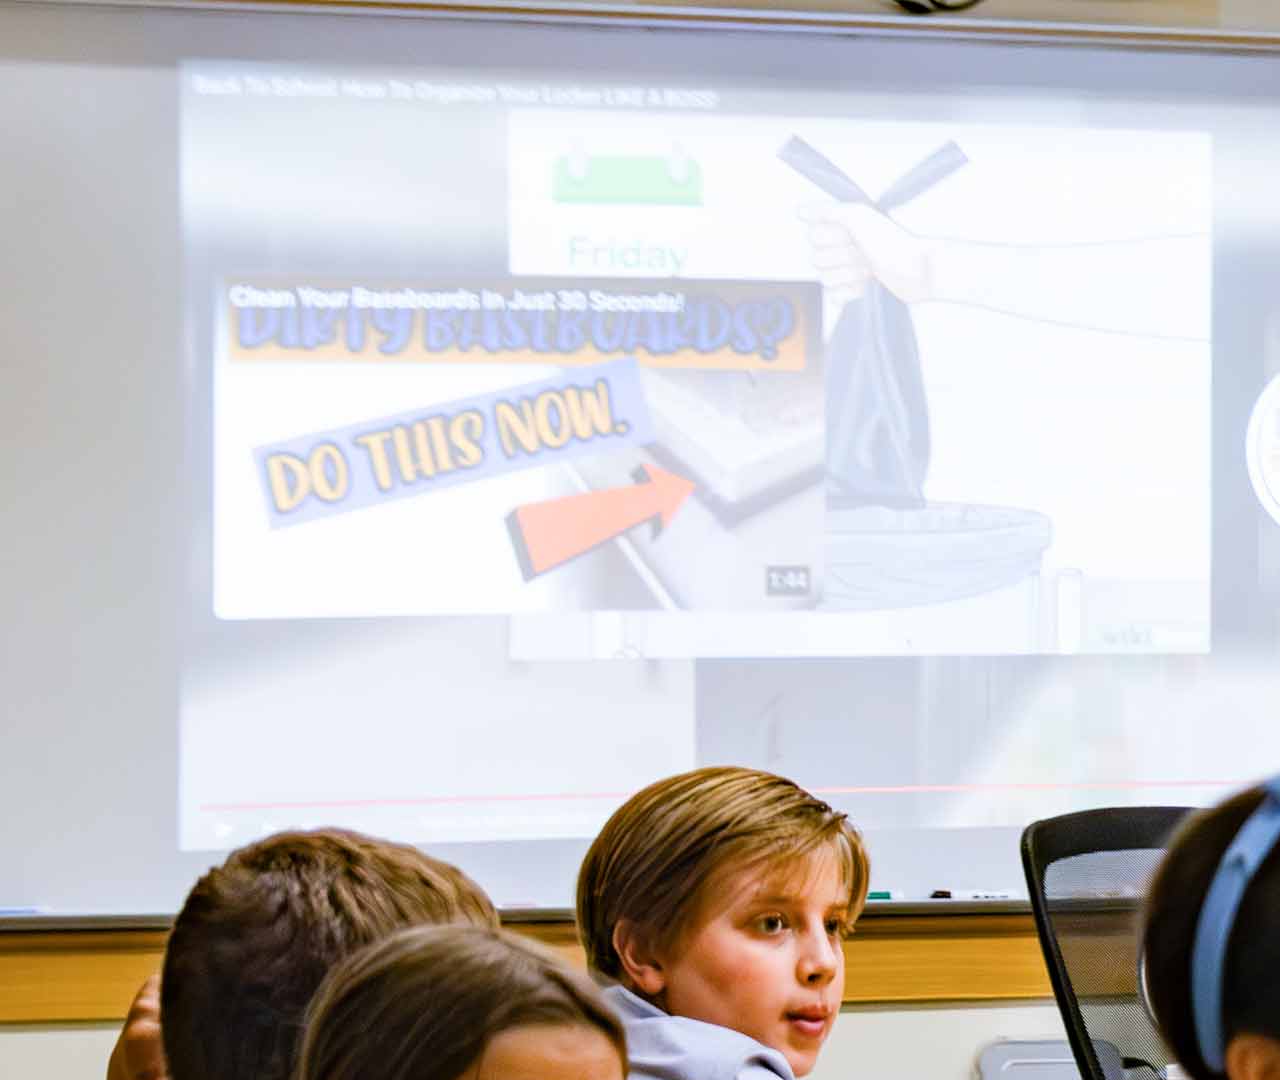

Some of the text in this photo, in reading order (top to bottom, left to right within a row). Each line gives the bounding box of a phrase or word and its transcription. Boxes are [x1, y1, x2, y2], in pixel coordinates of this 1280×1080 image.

[566, 233, 689, 278] Friday
[229, 284, 295, 310] Clean
[296, 285, 350, 310] Your
[351, 286, 481, 311] Baseboards
[508, 289, 556, 312] Just
[556, 290, 588, 312] 30
[589, 290, 686, 315] Seconds!
[264, 376, 630, 515] DO THIS NOW.
